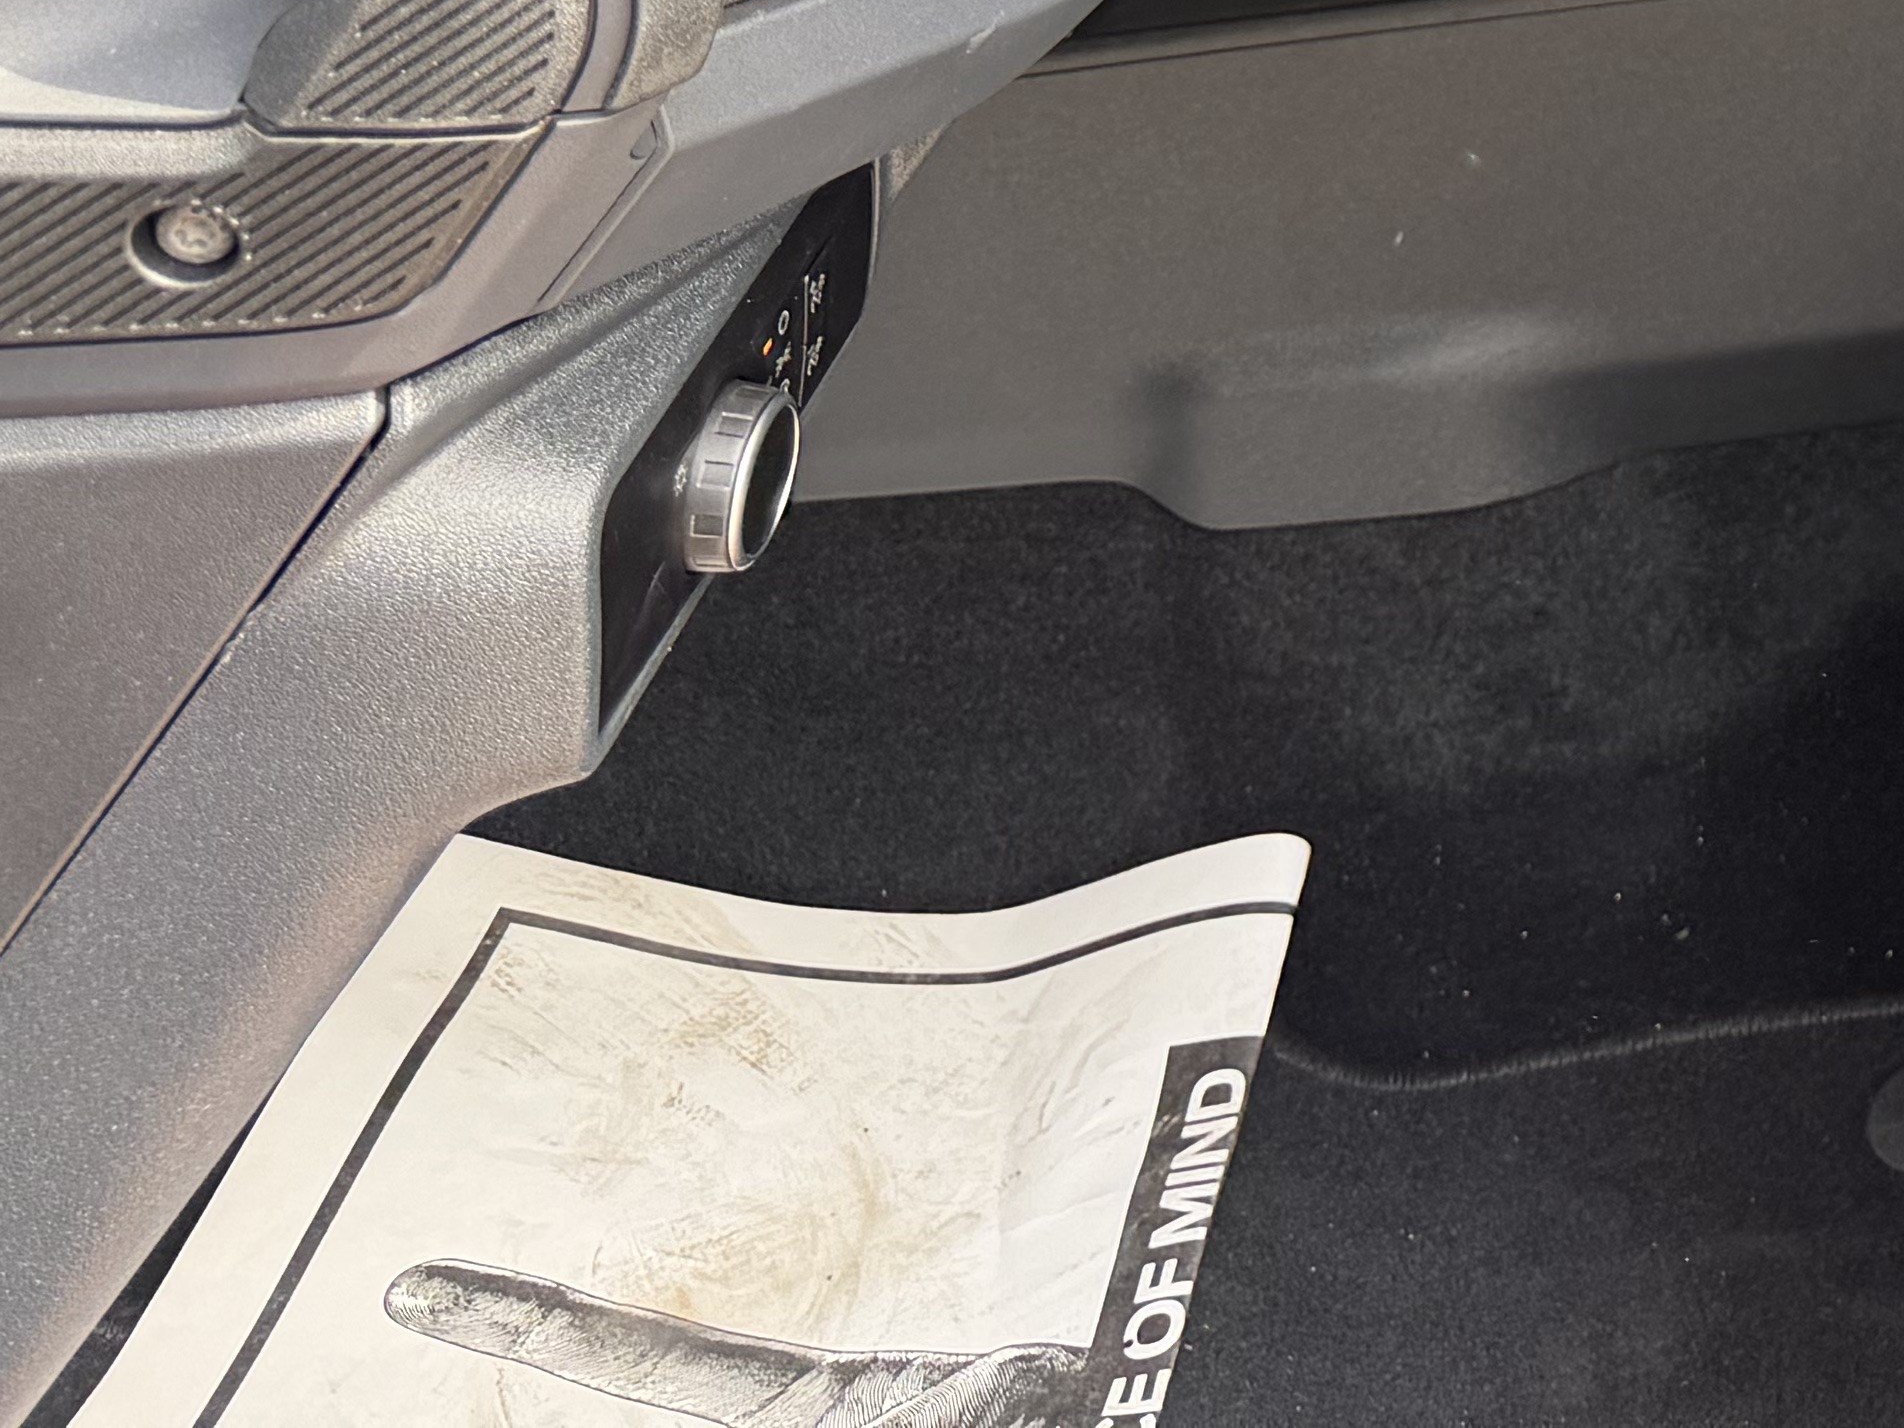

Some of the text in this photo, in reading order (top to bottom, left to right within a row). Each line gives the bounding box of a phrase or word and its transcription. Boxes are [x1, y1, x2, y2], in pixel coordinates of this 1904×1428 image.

[1095, 1067, 1247, 1428] E OF MIND
